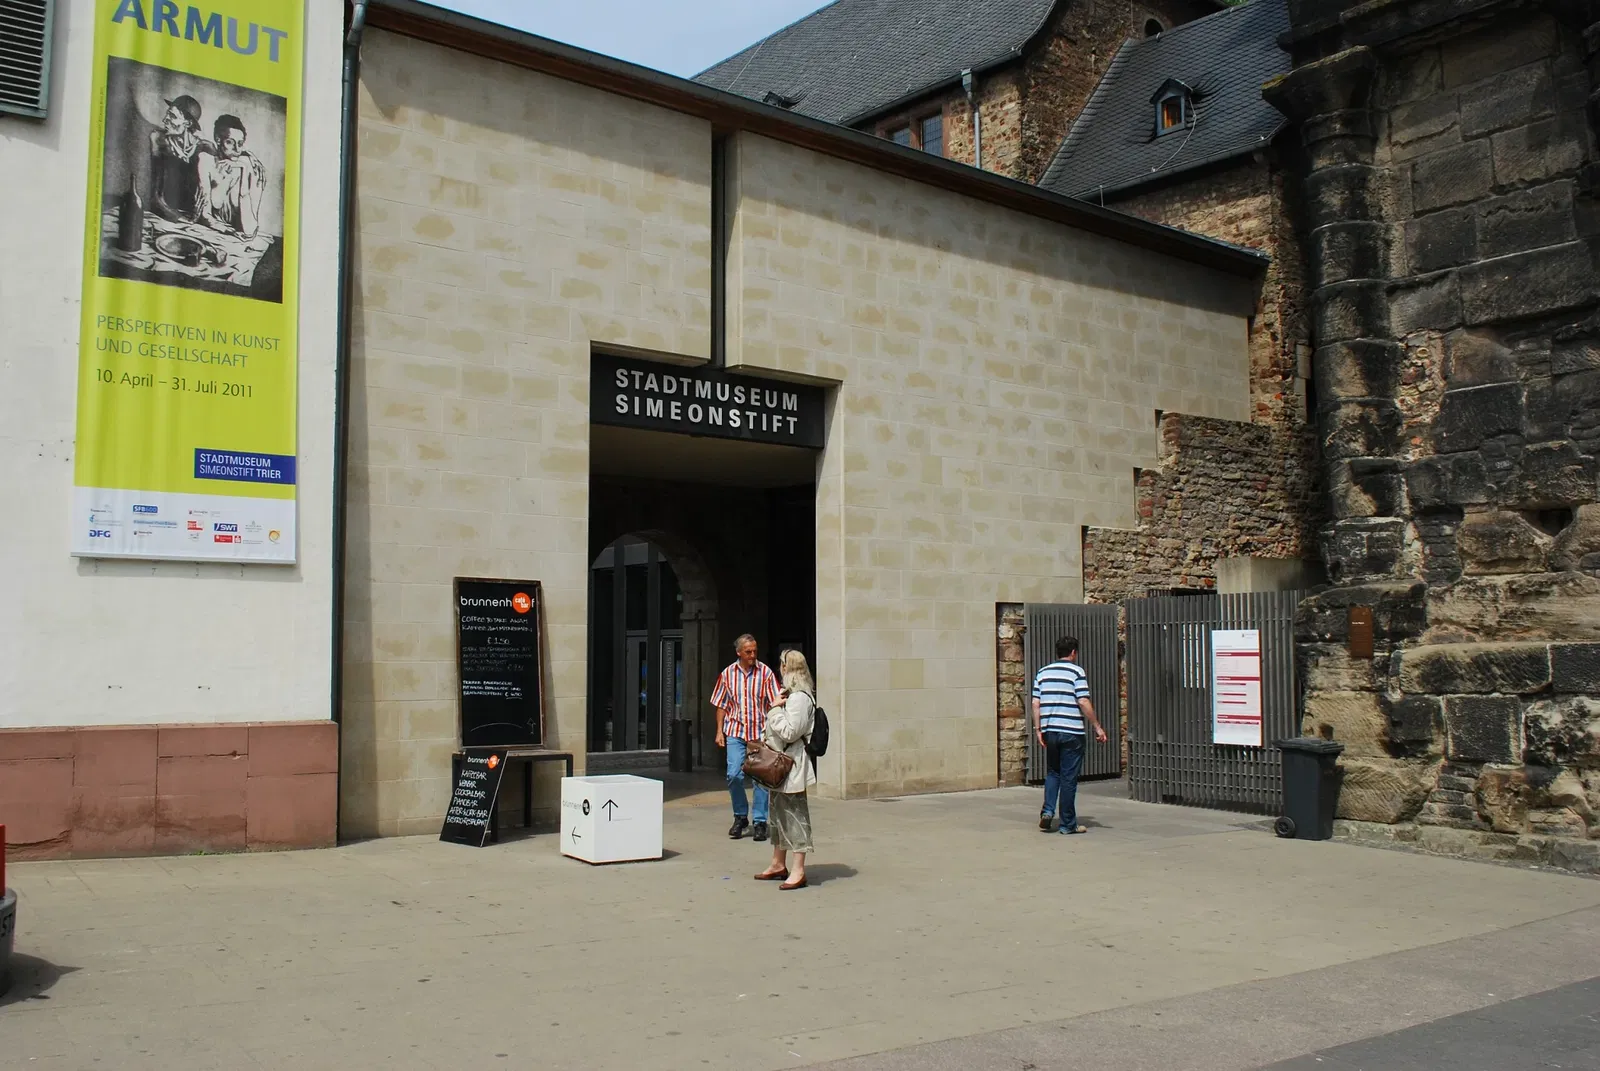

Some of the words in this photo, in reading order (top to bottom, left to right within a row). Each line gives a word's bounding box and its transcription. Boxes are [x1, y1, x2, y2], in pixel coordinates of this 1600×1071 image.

[111, 0, 288, 63] ARMUT
[97, 315, 206, 342] PERSPEKTIVEN
[212, 330, 227, 344] IN
[233, 333, 281, 351] KUNST
[96, 337, 132, 354] UND
[138, 342, 248, 368] GESELLSCHAFT
[96, 368, 116, 384] 10.
[120, 372, 154, 389] April
[172, 377, 191, 391] 31.
[195, 380, 217, 394] Juli
[222, 382, 252, 398] 2011
[615, 367, 798, 412] STADTMUSEUM
[615, 394, 798, 434] SIMEONSTIFT
[200, 453, 271, 467] STADTMUSEUM
[200, 465, 254, 477] SIMEONSTIFT
[256, 468, 281, 479] TRIER
[90, 530, 111, 538] DFG
[220, 524, 238, 532] SWT
